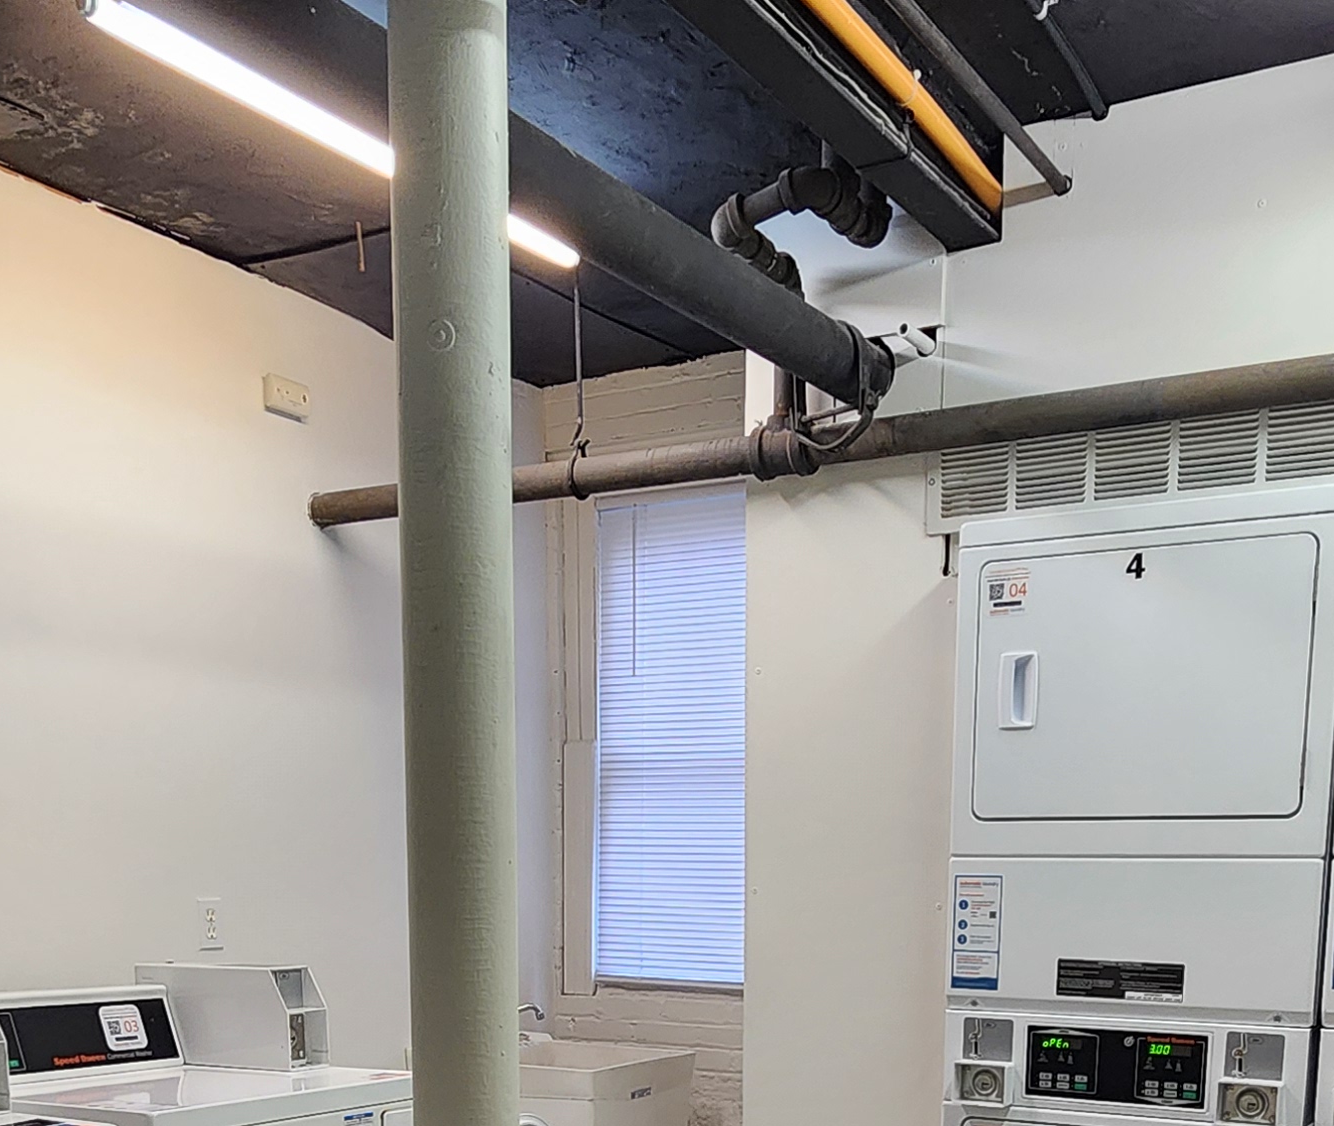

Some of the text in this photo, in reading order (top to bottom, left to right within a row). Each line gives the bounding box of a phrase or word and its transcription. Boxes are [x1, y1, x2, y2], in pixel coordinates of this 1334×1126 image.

[1126, 553, 1145, 579] 4
[1009, 582, 1027, 597] 04
[124, 1020, 139, 1032] 03
